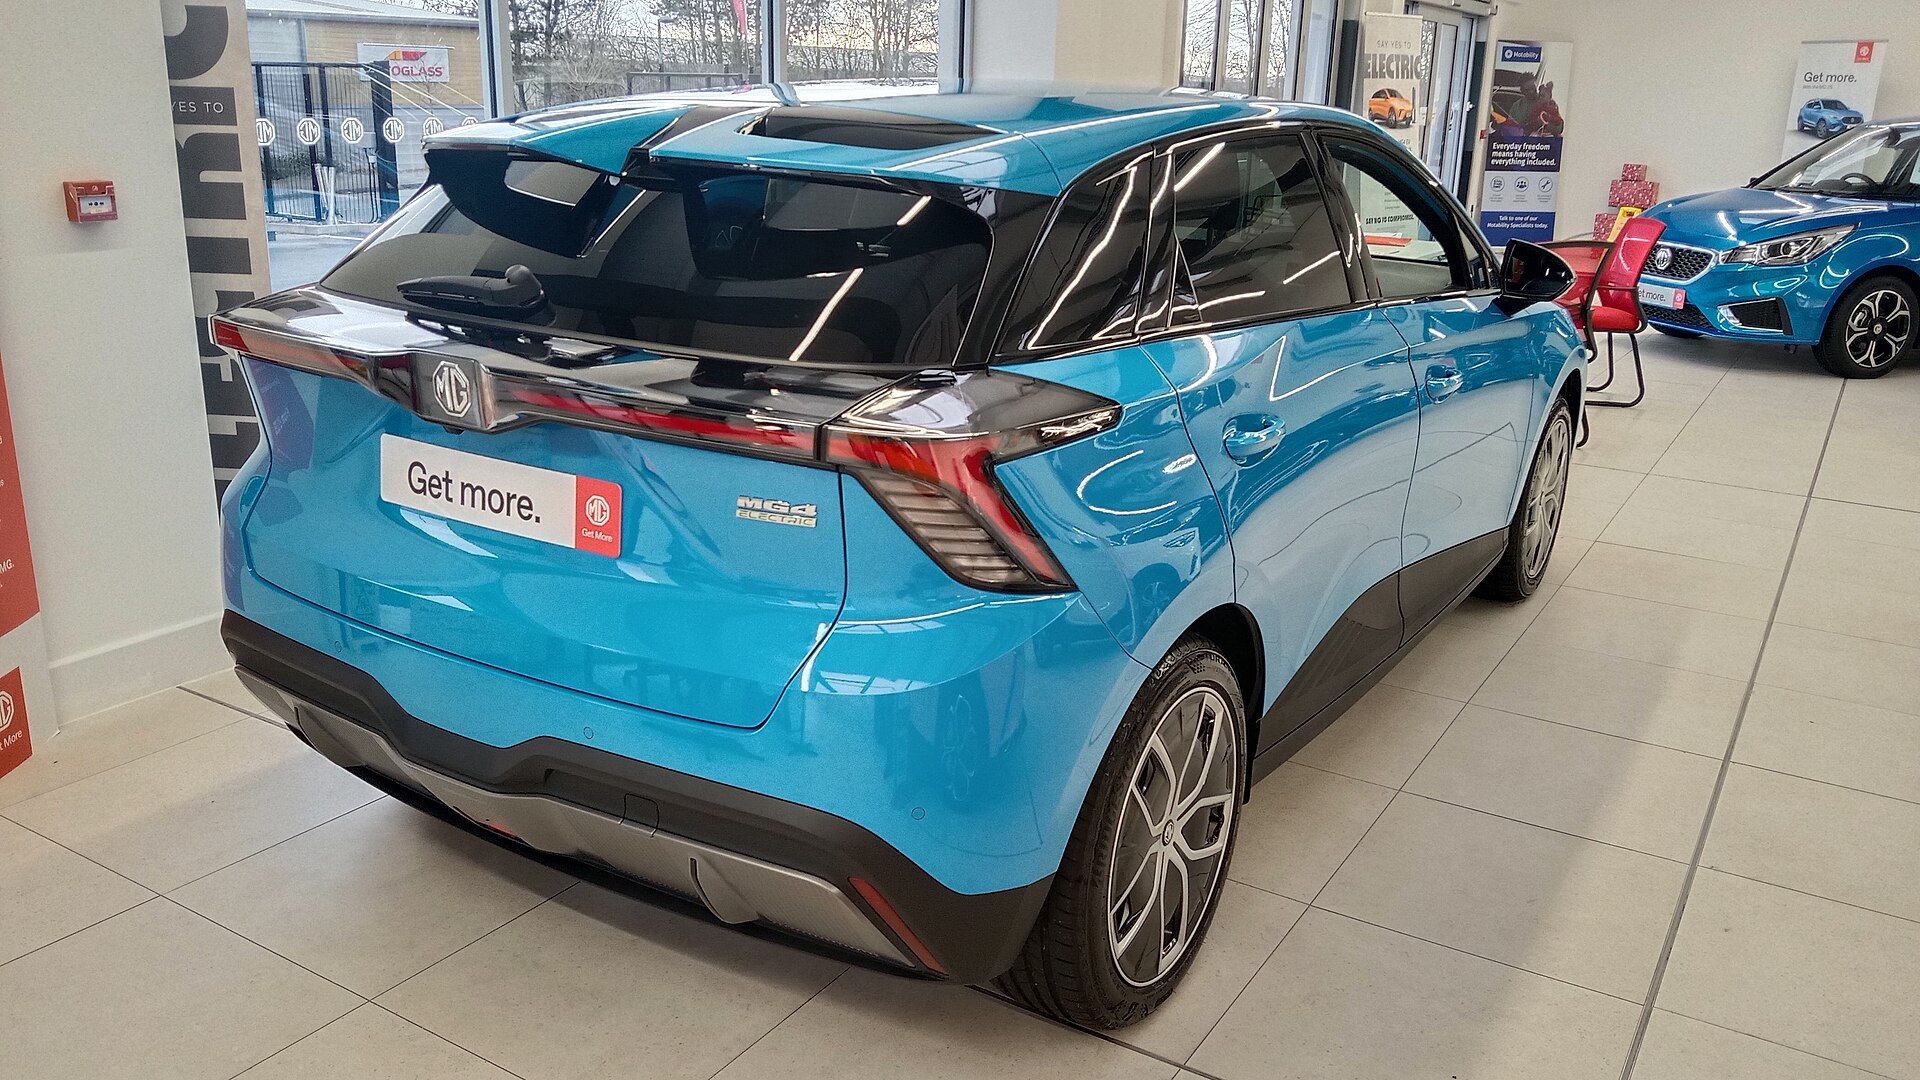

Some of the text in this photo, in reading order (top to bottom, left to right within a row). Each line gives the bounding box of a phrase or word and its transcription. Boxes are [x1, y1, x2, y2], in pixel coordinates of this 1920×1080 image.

[1377, 40, 1388, 48] SAY
[1391, 41, 1401, 49] YES
[1514, 51, 1539, 59] Motability
[390, 66, 443, 77] OGLASS
[1364, 54, 1421, 79] ELECTRIC
[1804, 71, 1857, 82] Get more.
[203, 102, 224, 113] TO
[1492, 142, 1522, 151] Everyday
[1514, 150, 1537, 159] having
[1491, 158, 1556, 167] everything included.
[1646, 292, 1665, 301] more.
[434, 363, 470, 415] MG
[408, 461, 540, 523] Get more.
[587, 497, 609, 523] MG
[737, 495, 818, 517] MG4
[738, 509, 815, 527] ELECTRIC
[581, 528, 613, 543] Get More
[3, 730, 23, 748] More
